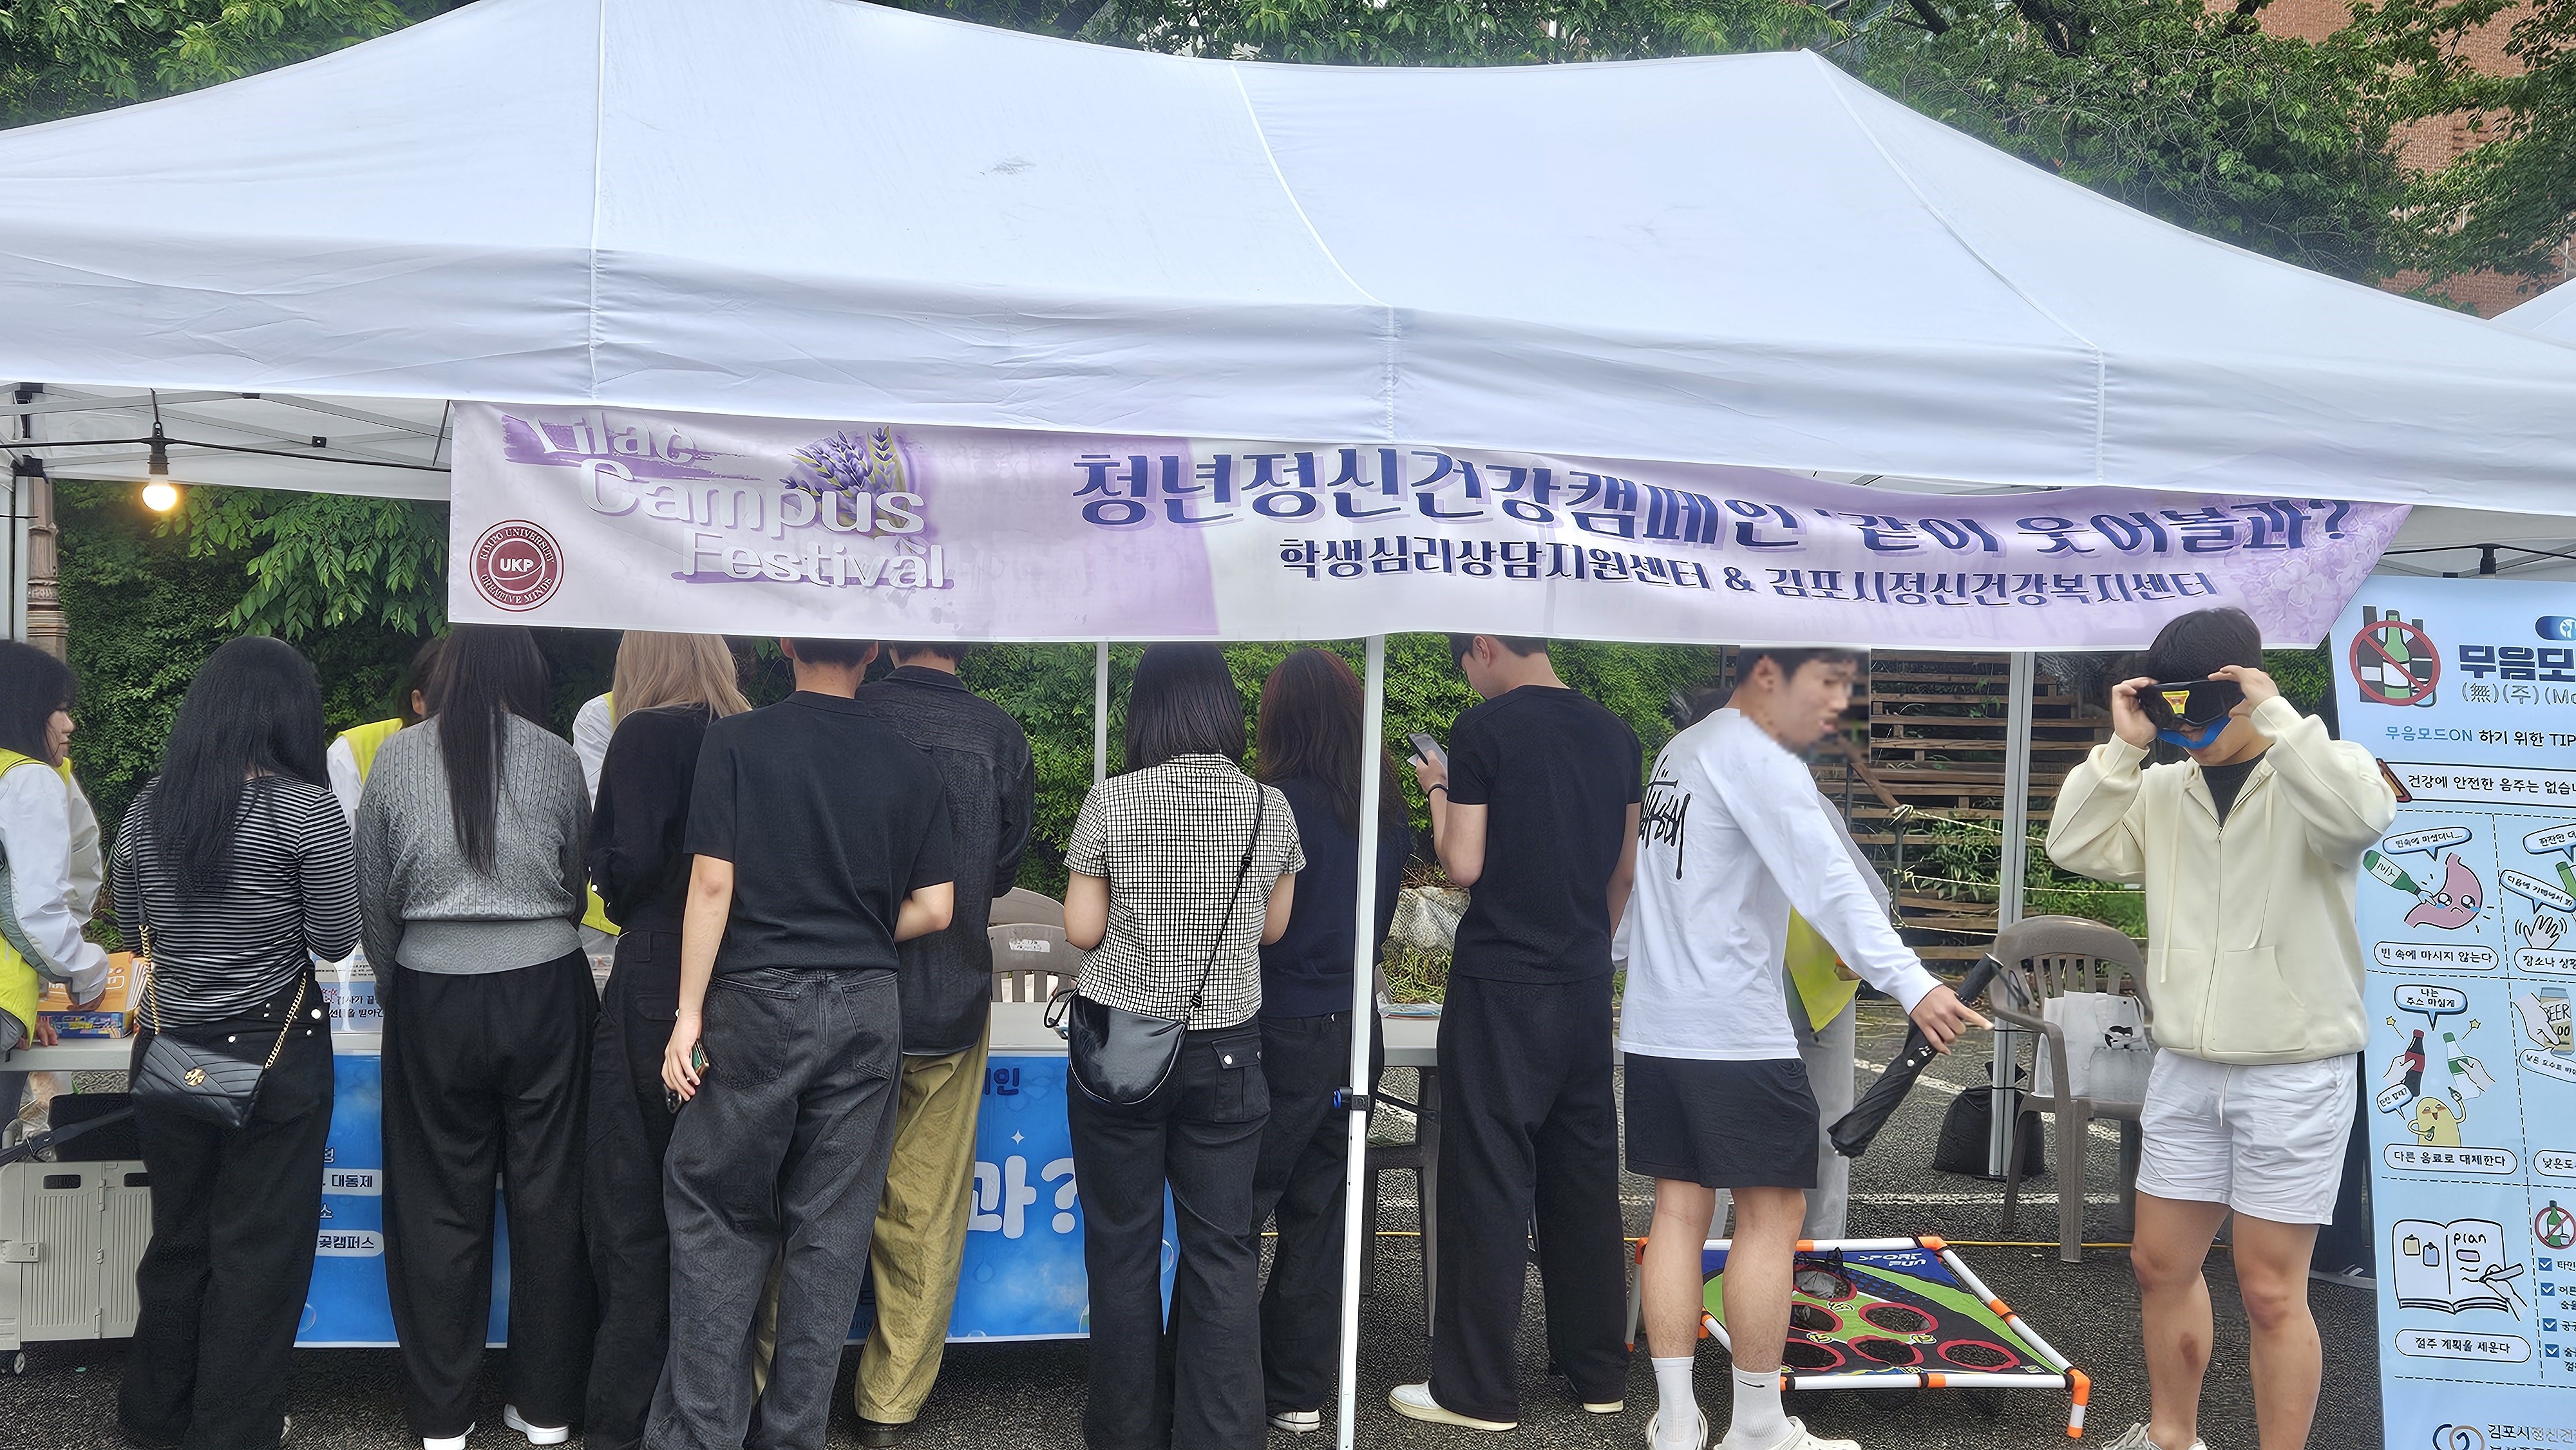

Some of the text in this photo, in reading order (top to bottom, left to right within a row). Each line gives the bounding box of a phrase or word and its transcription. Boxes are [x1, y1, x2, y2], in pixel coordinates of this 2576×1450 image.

[578, 458, 927, 541] Campus
[1072, 447, 1800, 548] 청년정신건강캠페인
[500, 558, 534, 572] UKP
[679, 527, 944, 588] Festival
[1278, 534, 2217, 607] 학생심리상담지원센터 & 김포시정신건강복지센터
[2385, 726, 2472, 742] 무음모드ON
[2479, 730, 2508, 746] 하기
[2514, 731, 2544, 748] 위한
[2409, 775, 2448, 789] 건강에
[2453, 777, 2494, 791] 안전한
[2499, 778, 2539, 793] 음주는
[2381, 948, 2493, 963] 빈 속에 마시지 않는다
[985, 1068, 1020, 1095] 인
[2394, 1151, 2416, 1163] 다른
[2543, 1158, 2576, 1170] 낮은도
[331, 1174, 373, 1188] 대동제
[2454, 1232, 2486, 1245] plan
[2477, 1341, 2510, 1354] 세운다
[2487, 1424, 2576, 1443] 김포시정신건
